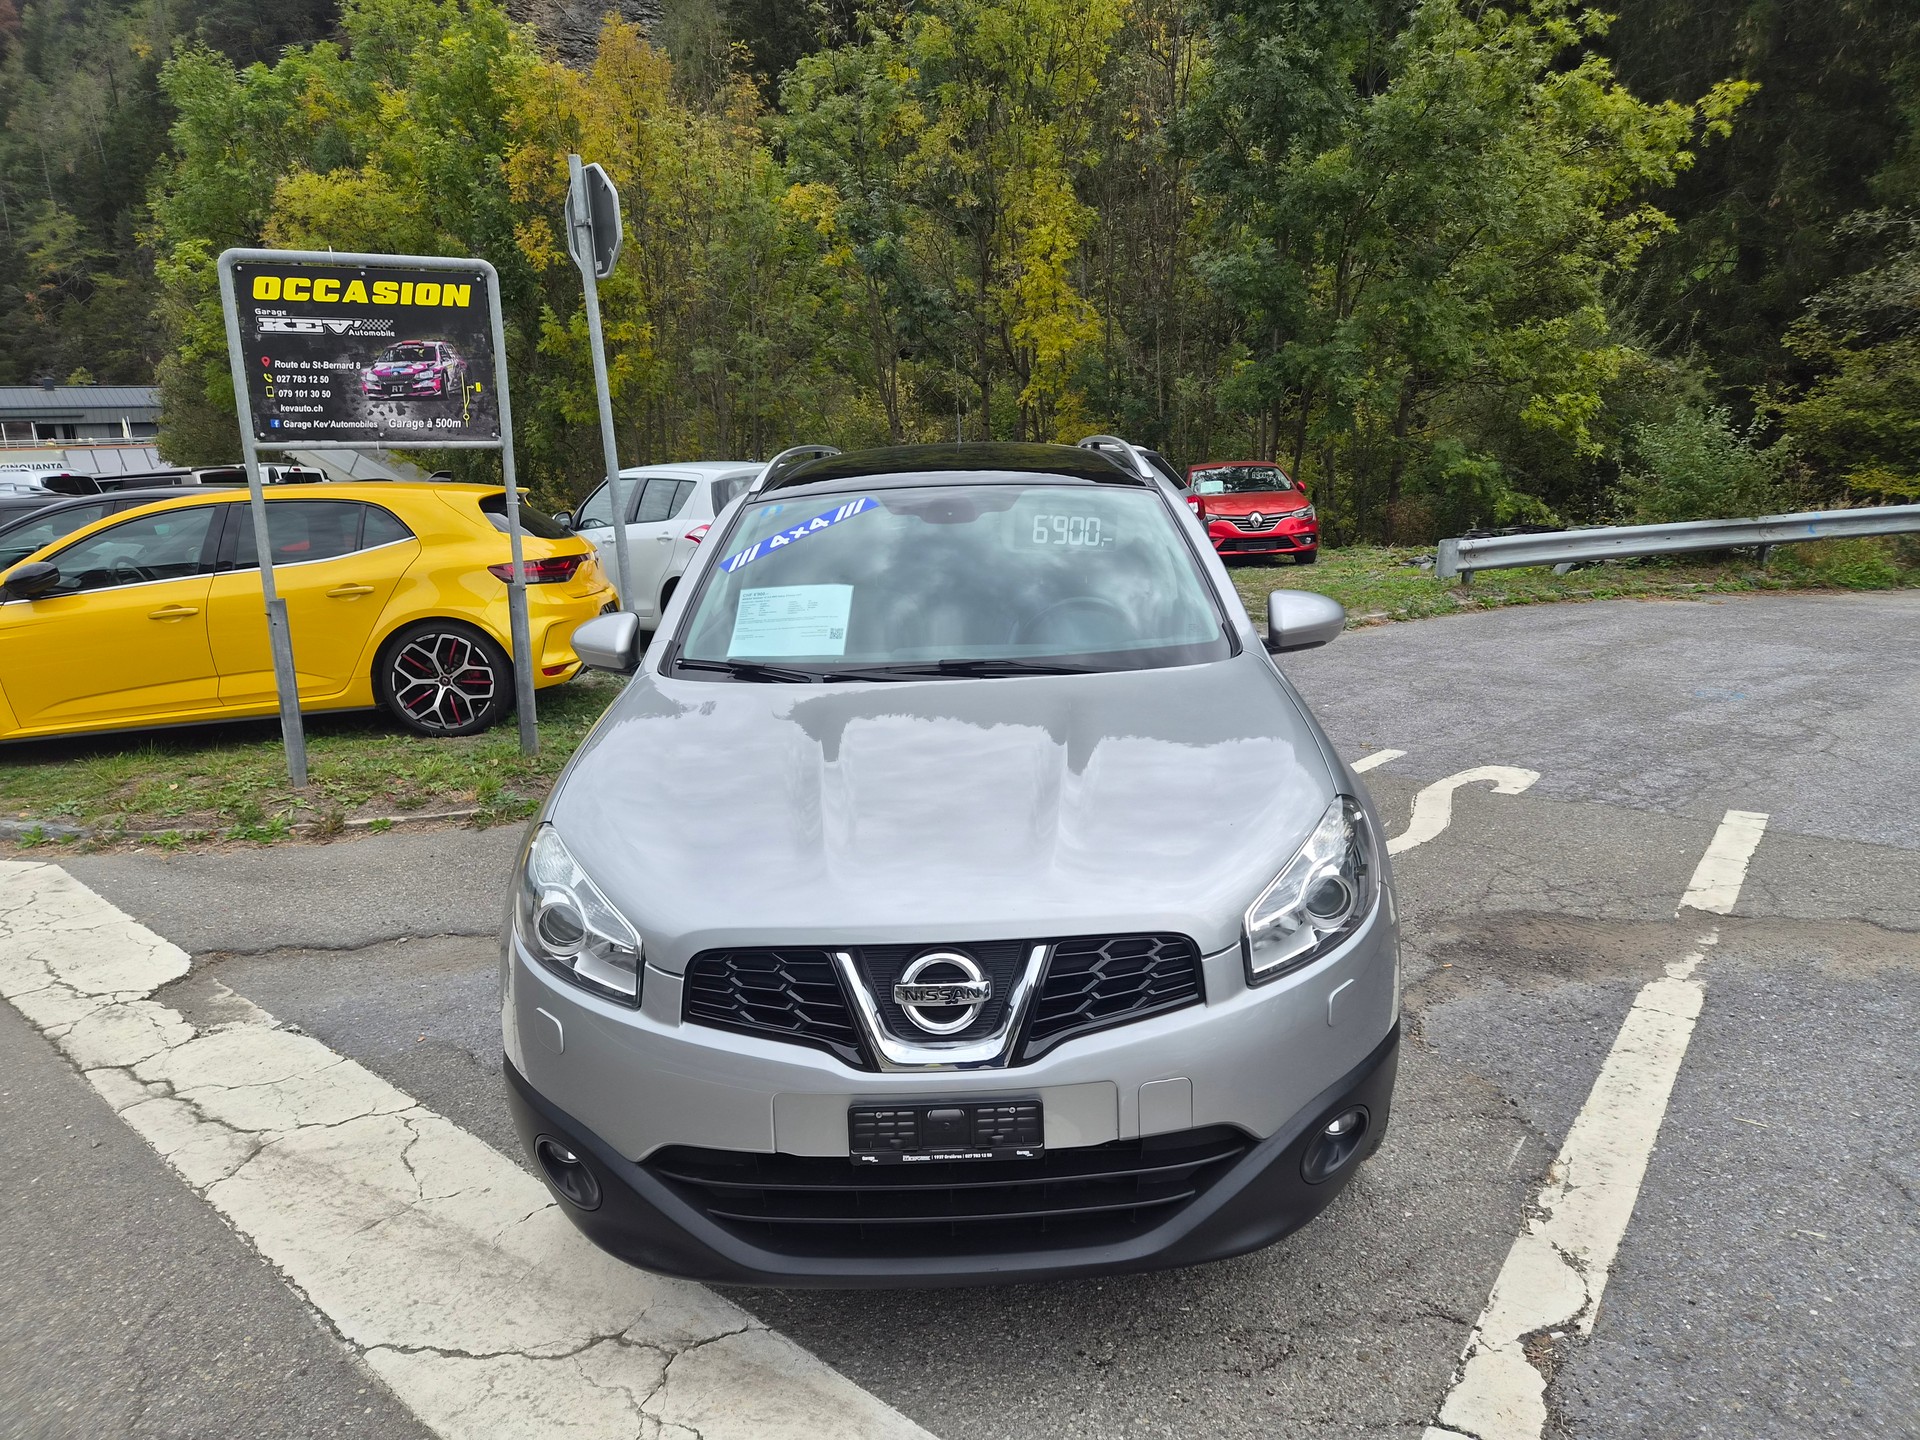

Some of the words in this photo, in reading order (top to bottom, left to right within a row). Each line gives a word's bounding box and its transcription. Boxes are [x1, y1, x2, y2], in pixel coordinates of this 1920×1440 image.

[253, 276, 471, 307] OCCASION
[254, 308, 287, 316] Garage
[348, 329, 396, 337] Automobile
[274, 360, 298, 369] Route
[300, 360, 310, 369] du
[312, 361, 354, 370] St-Bernard
[355, 361, 361, 370] 8
[276, 374, 291, 383] 027
[292, 375, 308, 384] 783
[309, 375, 318, 384] 12
[320, 375, 329, 384] 50
[278, 389, 293, 398] 079
[294, 390, 309, 398] 101
[310, 390, 320, 399] 30
[321, 390, 331, 399] 50
[280, 404, 324, 413] kevauto.ch
[283, 420, 312, 430] Garage
[313, 420, 378, 429] Kev'Automobiles
[388, 418, 425, 430] Garage
[426, 418, 433, 428] à
[434, 418, 462, 429] 500m
[904, 987, 980, 1002] NISSAN
